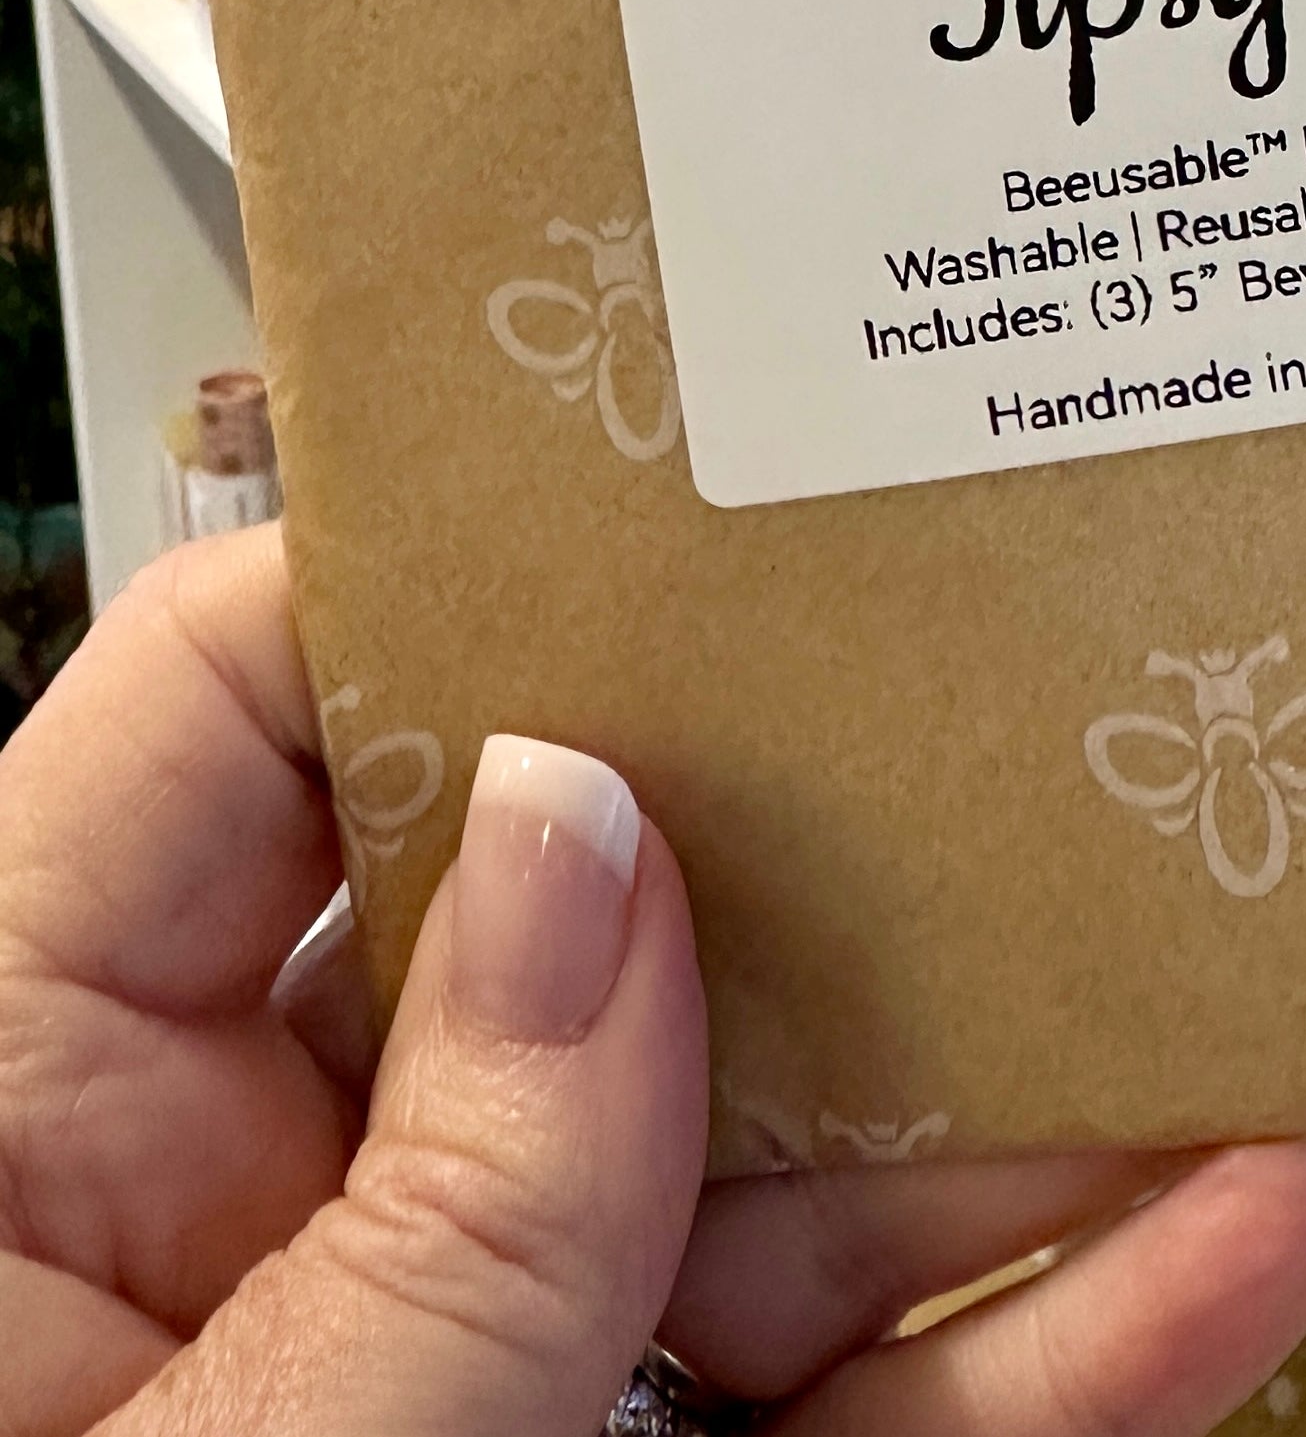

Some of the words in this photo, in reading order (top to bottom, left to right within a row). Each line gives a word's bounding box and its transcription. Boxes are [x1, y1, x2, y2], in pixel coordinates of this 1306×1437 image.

[884, 221, 1120, 292] Washable
[864, 298, 1074, 361] Includes:
[1090, 274, 1153, 331] (3)
[987, 360, 1252, 437] Handmade
